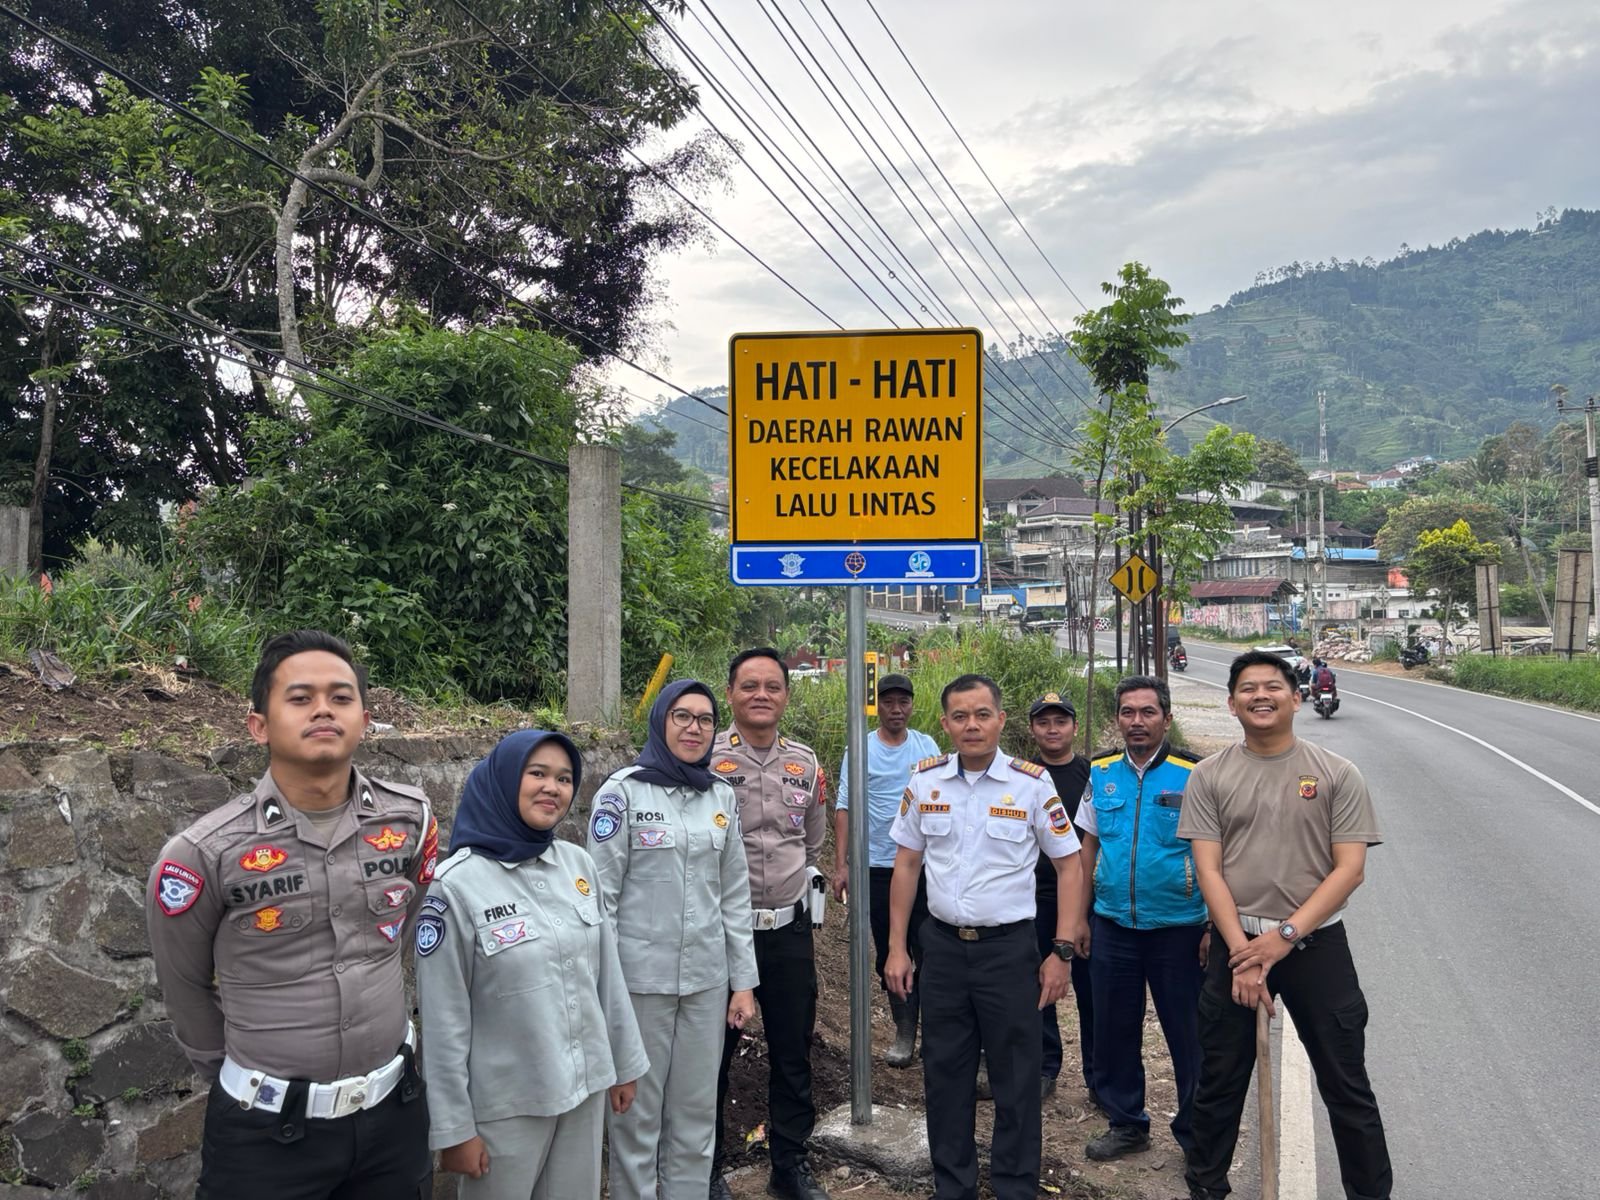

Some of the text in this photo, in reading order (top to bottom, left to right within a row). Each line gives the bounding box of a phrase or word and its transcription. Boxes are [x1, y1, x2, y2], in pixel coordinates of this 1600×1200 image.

[755, 359, 956, 400] HATI - HATI
[749, 416, 963, 444] DAERAH RAWAN
[770, 454, 939, 481] KECELAKAAN
[776, 491, 936, 517] LALU LINTAS
[782, 777, 810, 791] POLRI
[636, 811, 665, 822] ROSI
[231, 874, 304, 903] SYARIF
[484, 903, 517, 922] FIRLY
